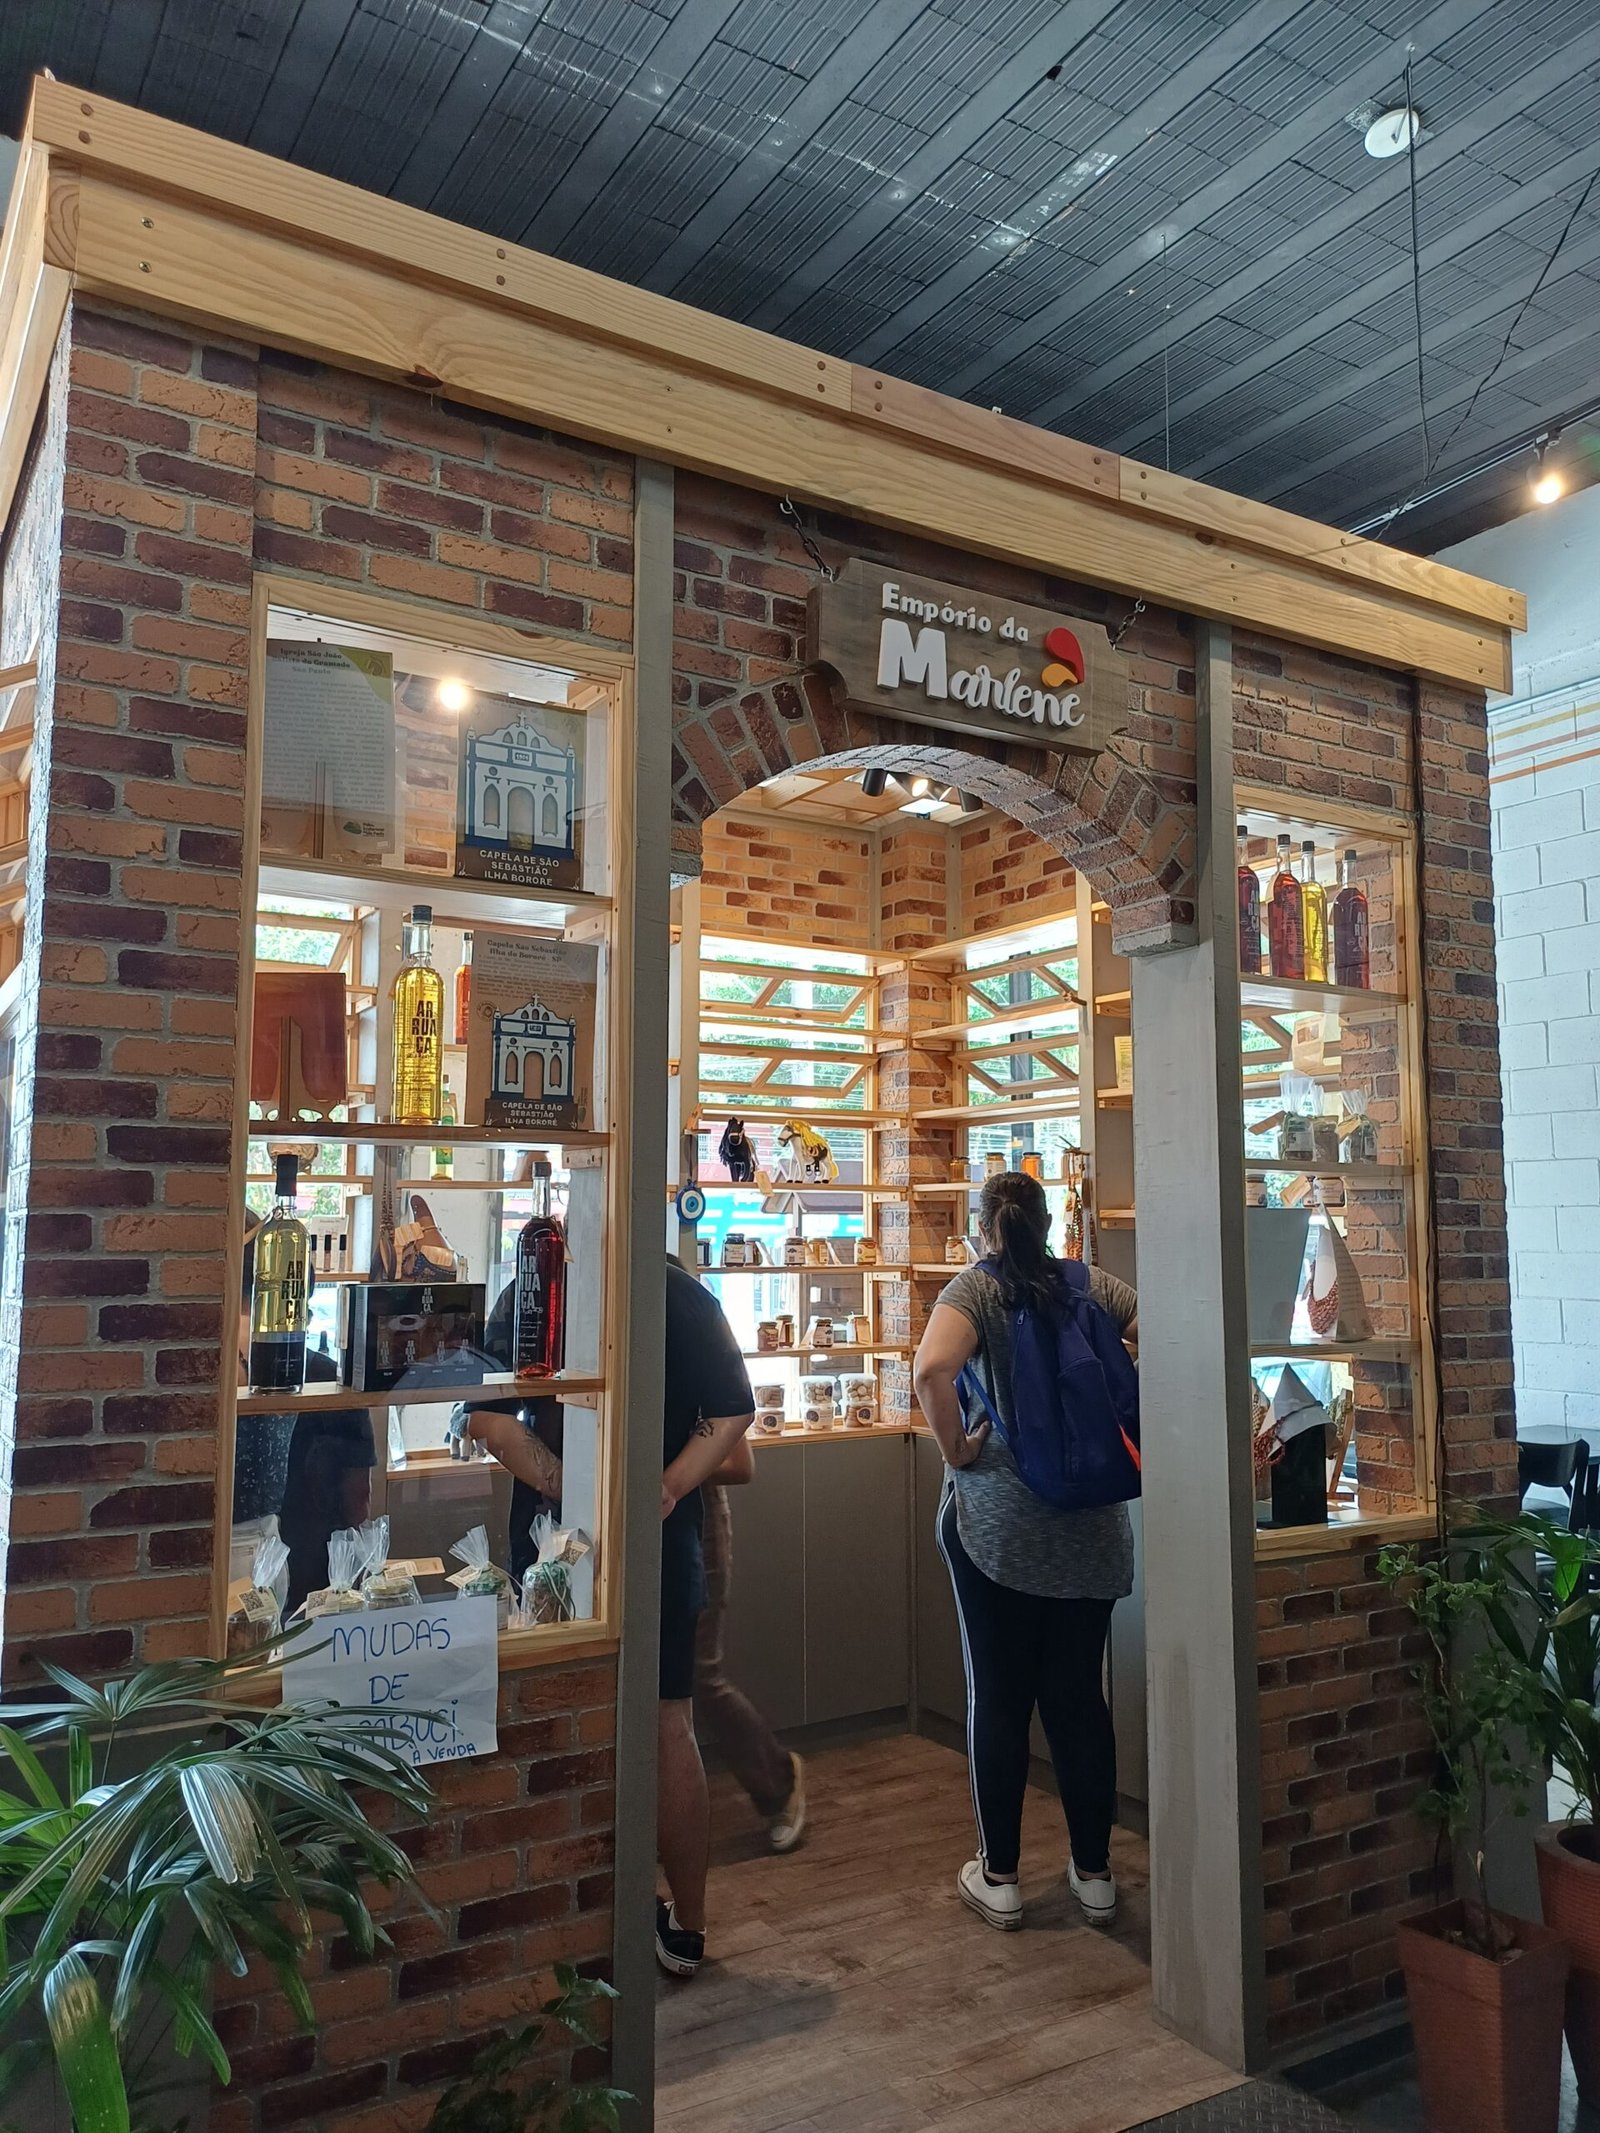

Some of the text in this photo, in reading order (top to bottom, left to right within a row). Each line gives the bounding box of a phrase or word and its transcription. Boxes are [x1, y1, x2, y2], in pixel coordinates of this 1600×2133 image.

[882, 582, 1029, 643] Empório da
[280, 647, 306, 657] Igreja
[323, 651, 343, 660] João
[877, 617, 1085, 727] Marlene
[480, 849, 560, 868] CAPELA DE SÃO
[484, 870, 509, 881] ILHA
[491, 861, 549, 876] SEBASTIÃO
[487, 939, 514, 949] Capela
[490, 948, 506, 957] Ilha
[416, 1000, 433, 1018] AR
[412, 1018, 437, 1037] RUA
[502, 1102, 533, 1110] CAPELA
[510, 1110, 554, 1118] SEBASTIÃO
[286, 1260, 303, 1279] AR
[521, 1255, 538, 1273] AR
[281, 1280, 305, 1300] RUA
[332, 1618, 451, 1662] MUDAS
[369, 1673, 409, 1705] DE
[427, 1743, 477, 1760] VENDA
